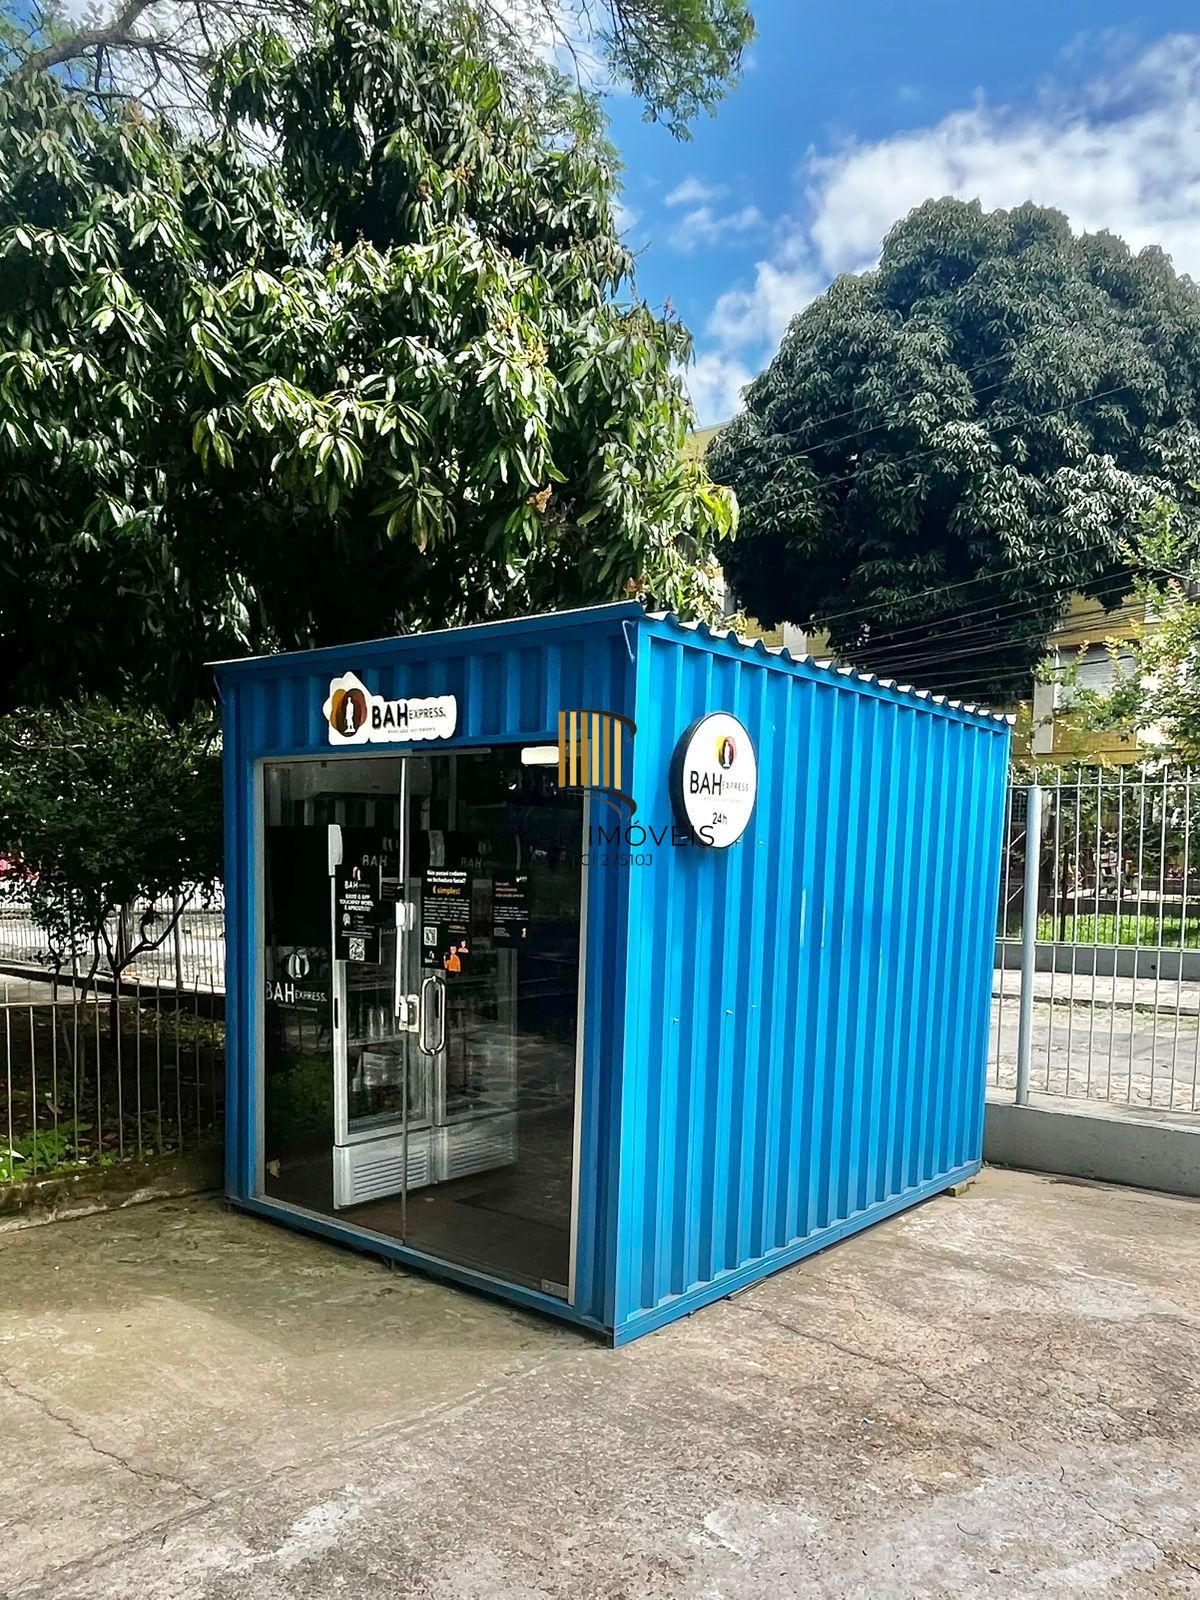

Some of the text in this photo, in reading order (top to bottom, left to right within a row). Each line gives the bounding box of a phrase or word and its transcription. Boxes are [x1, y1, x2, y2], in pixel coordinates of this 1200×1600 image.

[372, 703, 408, 729] BAH
[690, 770, 749, 795] BAH EXPRESS
[712, 812, 728, 825] 24h
[266, 981, 295, 1003] BAH
